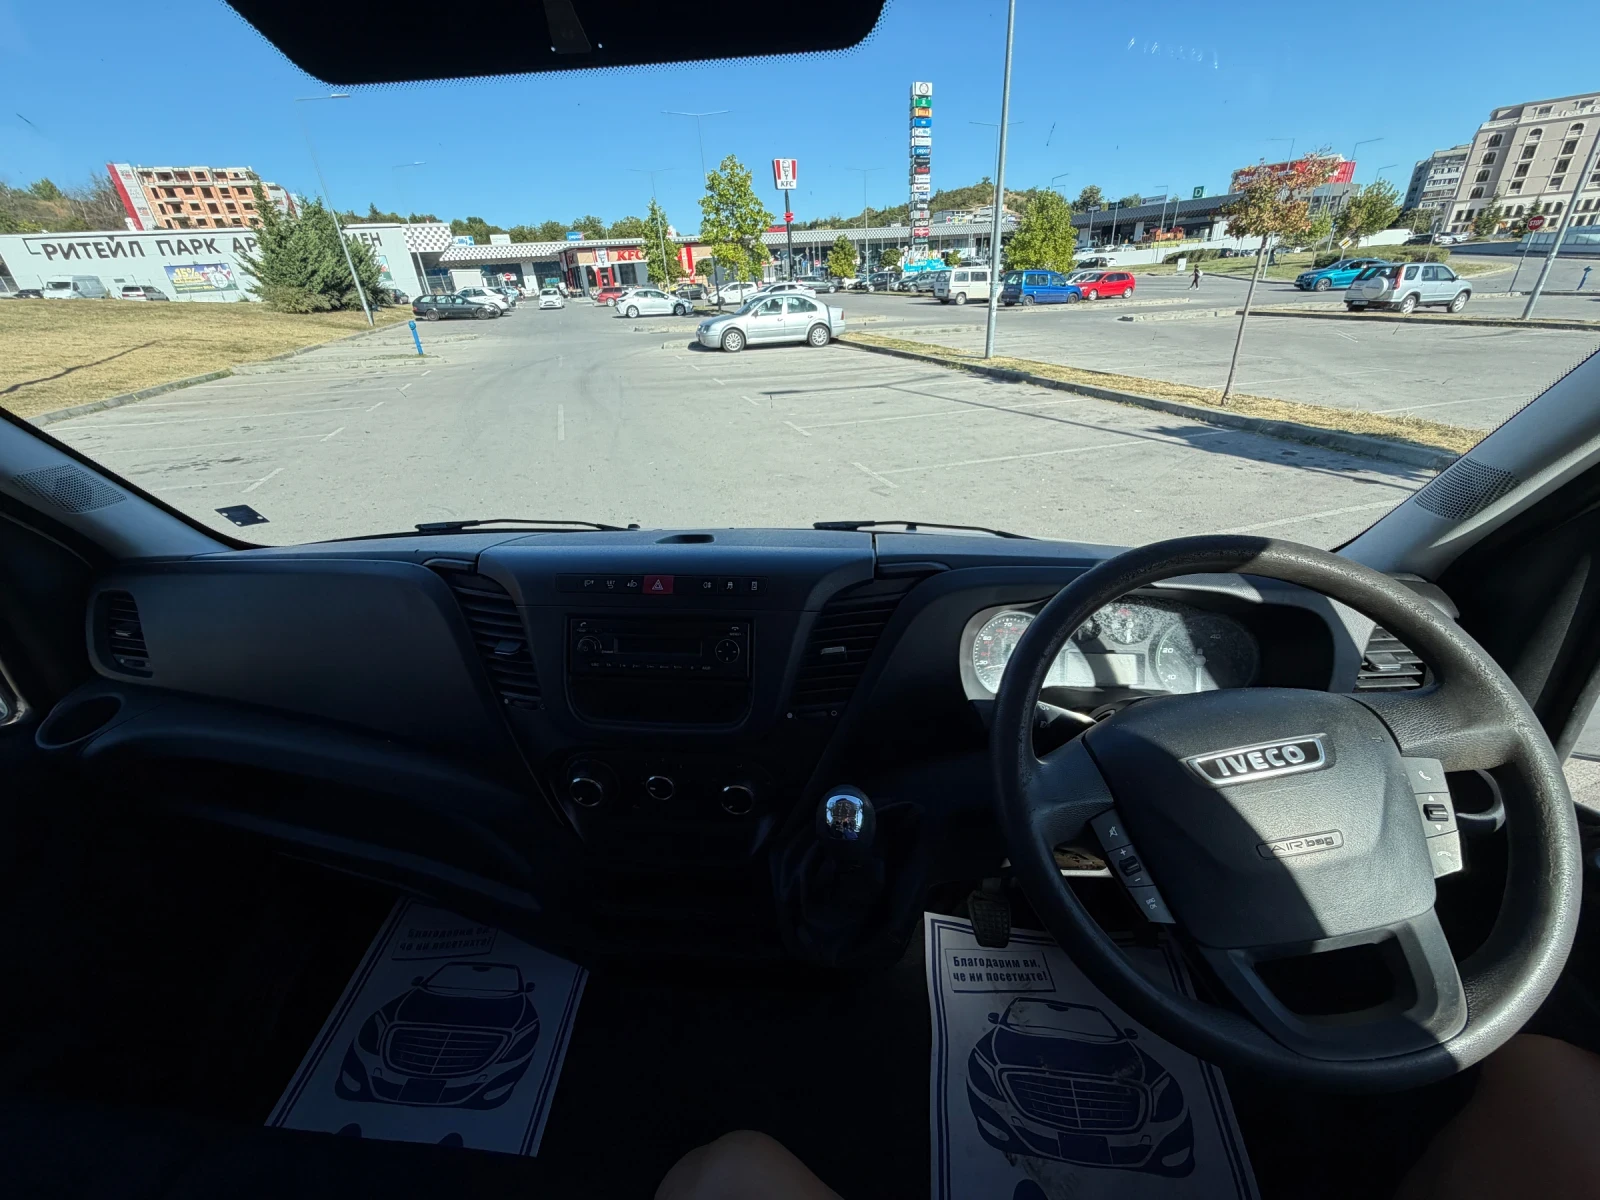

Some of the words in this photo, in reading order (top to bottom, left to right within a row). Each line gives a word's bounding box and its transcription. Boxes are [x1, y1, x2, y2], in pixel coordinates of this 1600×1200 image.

[780, 180, 794, 188] KFC
[1194, 188, 1202, 197] D
[1529, 219, 1543, 227] STOP
[40, 235, 146, 261] РИТЕЙЛ
[155, 237, 222, 257] ПАРК
[1214, 744, 1307, 777] IVECO
[399, 943, 412, 951] че
[415, 942, 429, 951] ни
[953, 956, 1021, 968] Благодарим
[1023, 959, 1041, 968] ви,
[952, 972, 966, 982] че
[969, 972, 983, 982] ни
